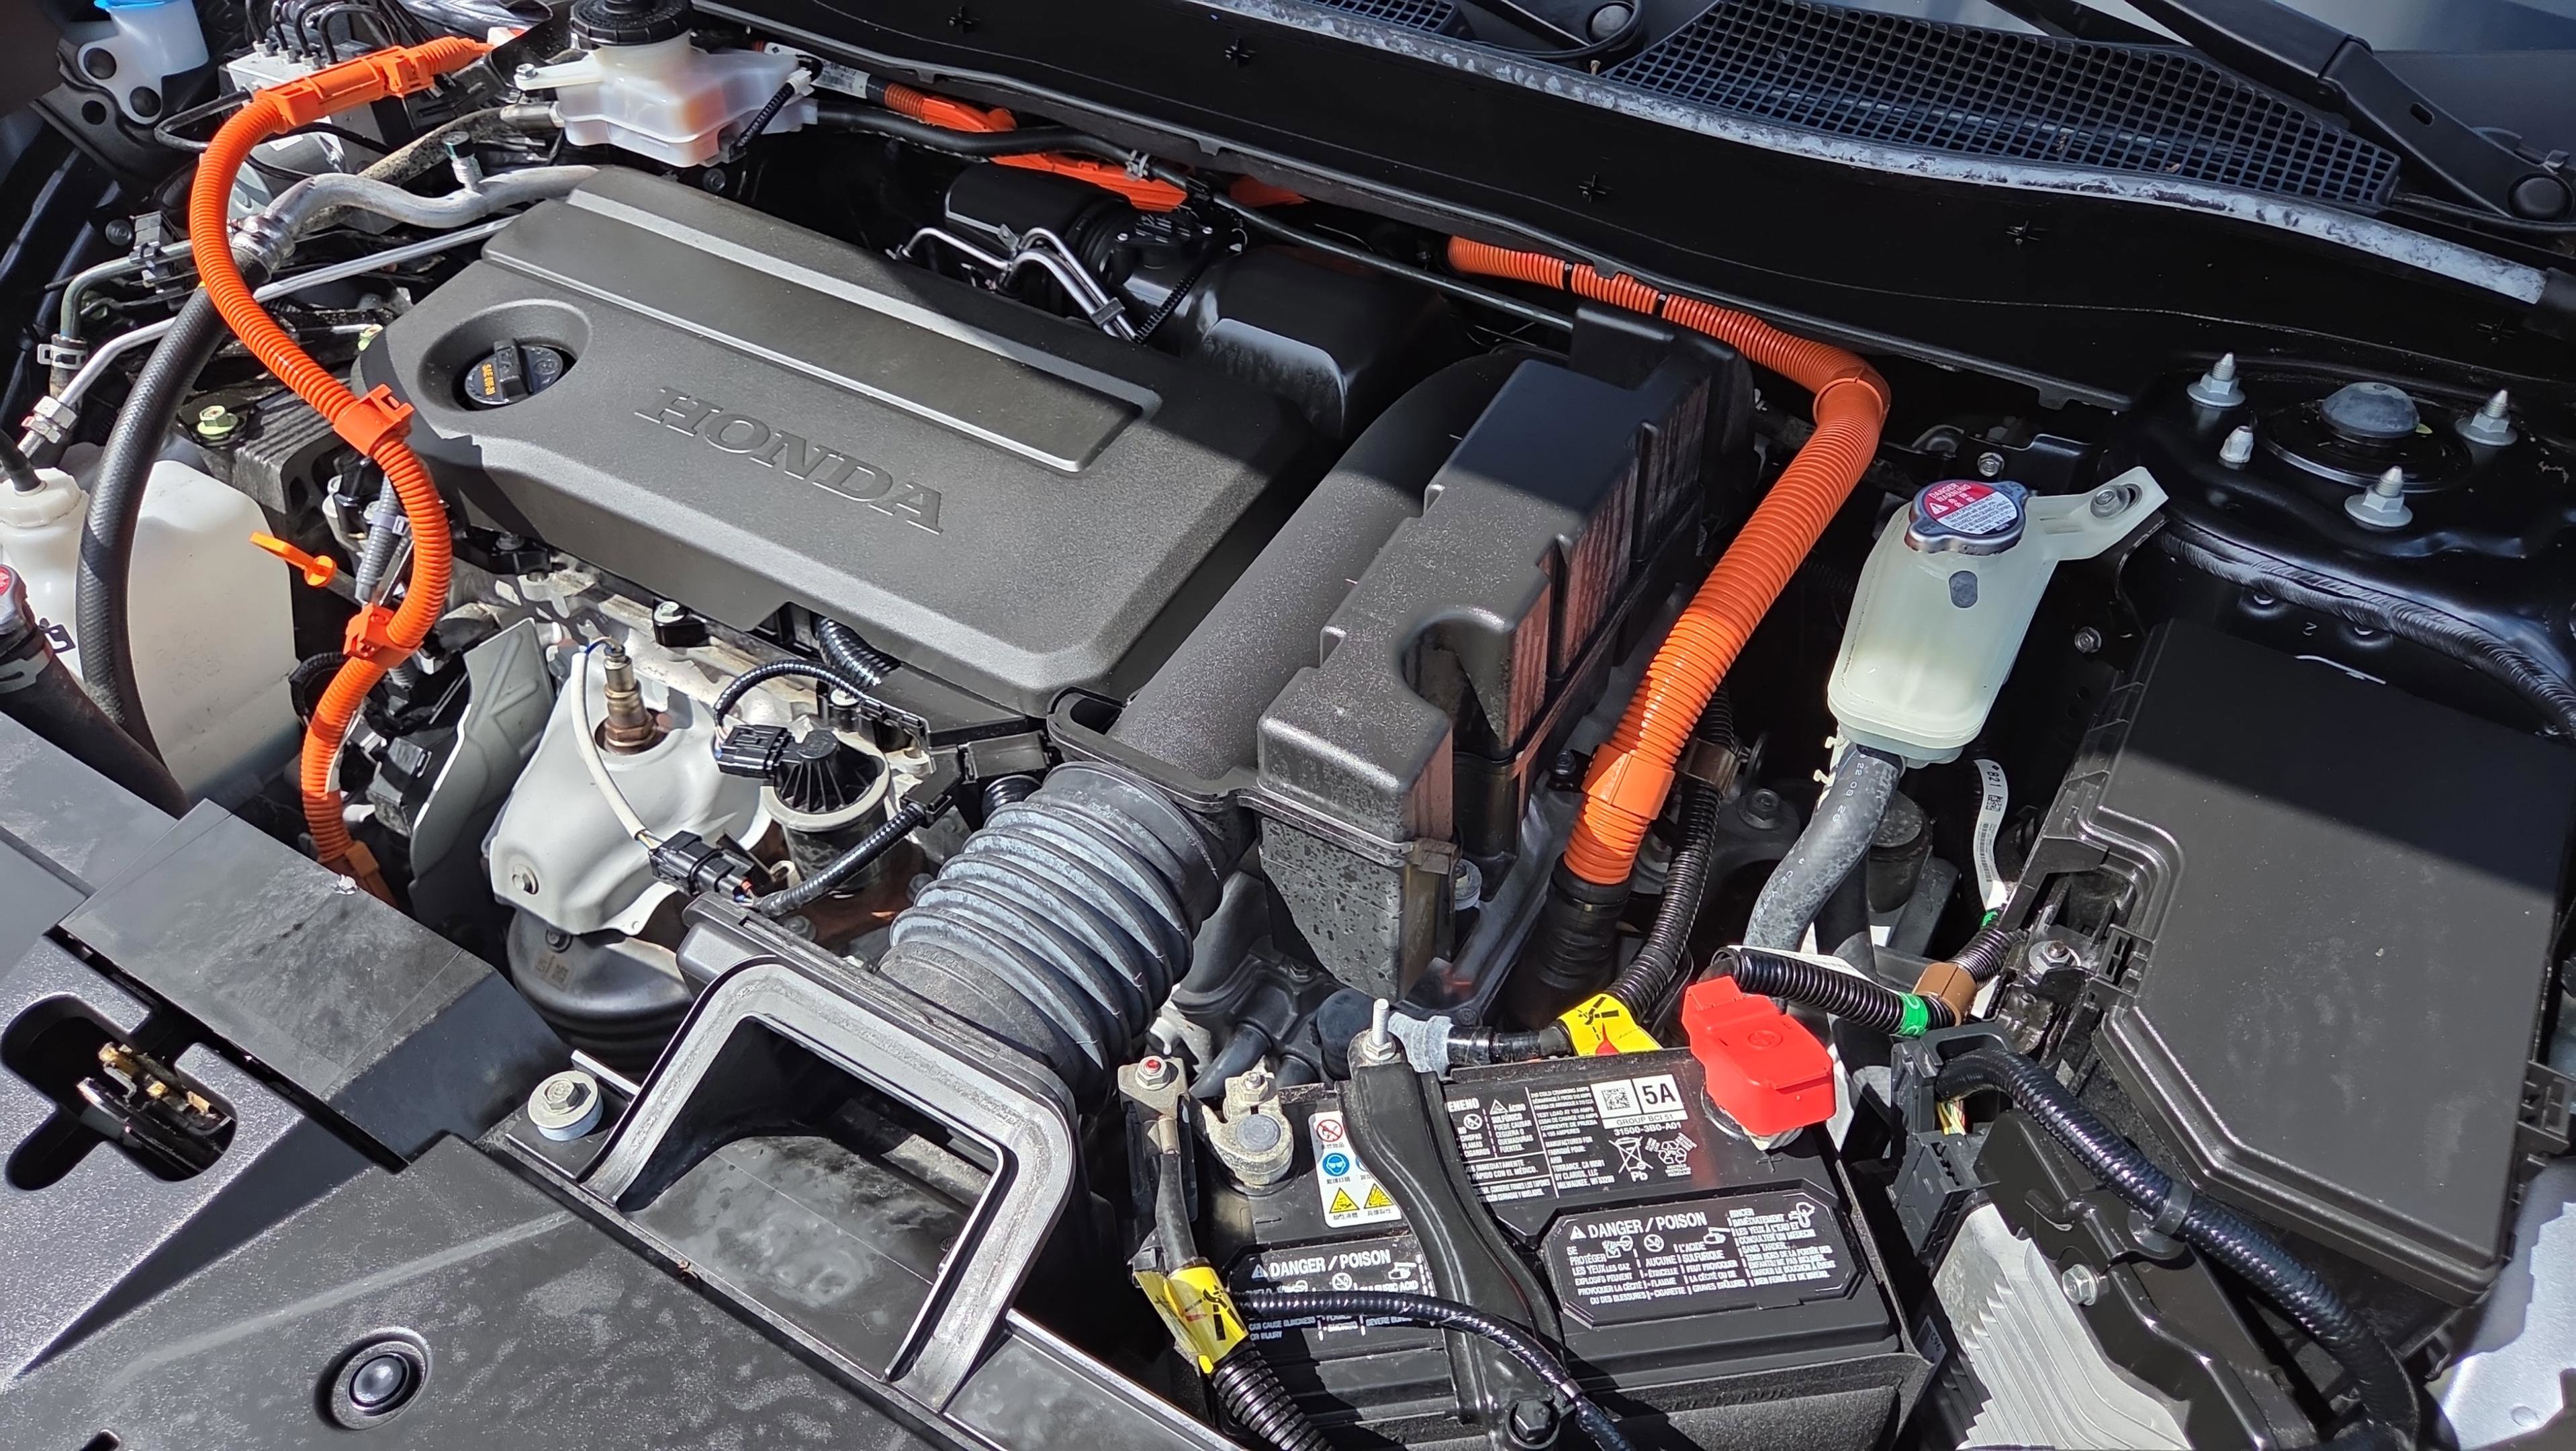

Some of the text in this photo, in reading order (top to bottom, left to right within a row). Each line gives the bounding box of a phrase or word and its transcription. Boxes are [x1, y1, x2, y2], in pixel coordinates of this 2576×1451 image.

[635, 386, 944, 535] HONDA
[1929, 483, 1958, 498] DANGER
[1935, 484, 1972, 502] WARNING
[1642, 1083, 1676, 1104] 5A
[1447, 1098, 1479, 1112] ENENO
[1493, 1120, 1532, 1131] PUEDE CAUSAR
[1614, 1122, 1682, 1136] 31500-3B0-A01
[1496, 1130, 1520, 1138] CEGUERA
[1557, 1128, 1580, 1136] AMPERES
[1460, 1133, 1482, 1142] CHISPAS
[1498, 1135, 1534, 1145] QUEMADURAS
[1545, 1138, 1582, 1147] MANUFACTURED
[1462, 1141, 1483, 1150] FLAMAS
[1500, 1144, 1525, 1153] FUERTES.
[1464, 1148, 1491, 1157] CIGARROS
[1476, 1159, 1524, 1172] INMEDIATAMENTE
[1552, 1163, 1581, 1172] TORRANCE,
[1555, 1173, 1562, 1181] BY
[1563, 1171, 1588, 1179] CLARIOS,
[1630, 1172, 1649, 1182] Pb
[1557, 1179, 1590, 1189] MILWAUKEE,
[1729, 1208, 1755, 1218] RINCER
[1588, 1219, 1644, 1239] DANGER
[1655, 1212, 1708, 1231] POISON
[1735, 1227, 1748, 1236] LES
[1749, 1225, 1765, 1235] YEUX
[1790, 1222, 1800, 1230] ET
[1739, 1233, 1775, 1244] CONSULTER
[1776, 1233, 1786, 1241] UN
[1567, 1247, 1578, 1256] SE
[1679, 1241, 1706, 1253] L'ACIDE
[1741, 1245, 1760, 1254] SANS
[1569, 1253, 1607, 1266] PROTÉGER
[1646, 1255, 1677, 1268] AUCUNE
[1682, 1250, 1725, 1264] SULFURIQUE
[1786, 1257, 1798, 1265] PAS
[1269, 1258, 1326, 1279] DANGER
[1339, 1249, 1391, 1270] POISON
[1686, 1260, 1738, 1273] PEUT PROVOQUER
[1572, 1267, 1586, 1276] LES
[1575, 1273, 1632, 1286] EXPLOSIFS PEUVENT
[1689, 1275, 1698, 1283] LA
[1578, 1286, 1614, 1296] PROVOQUER
[1692, 1283, 1716, 1292] GRAVES
[1590, 1292, 1646, 1305] OU DES BLESSURES
[1262, 1320, 1283, 1329] CAUSE
[1250, 1333, 1260, 1341] OR
